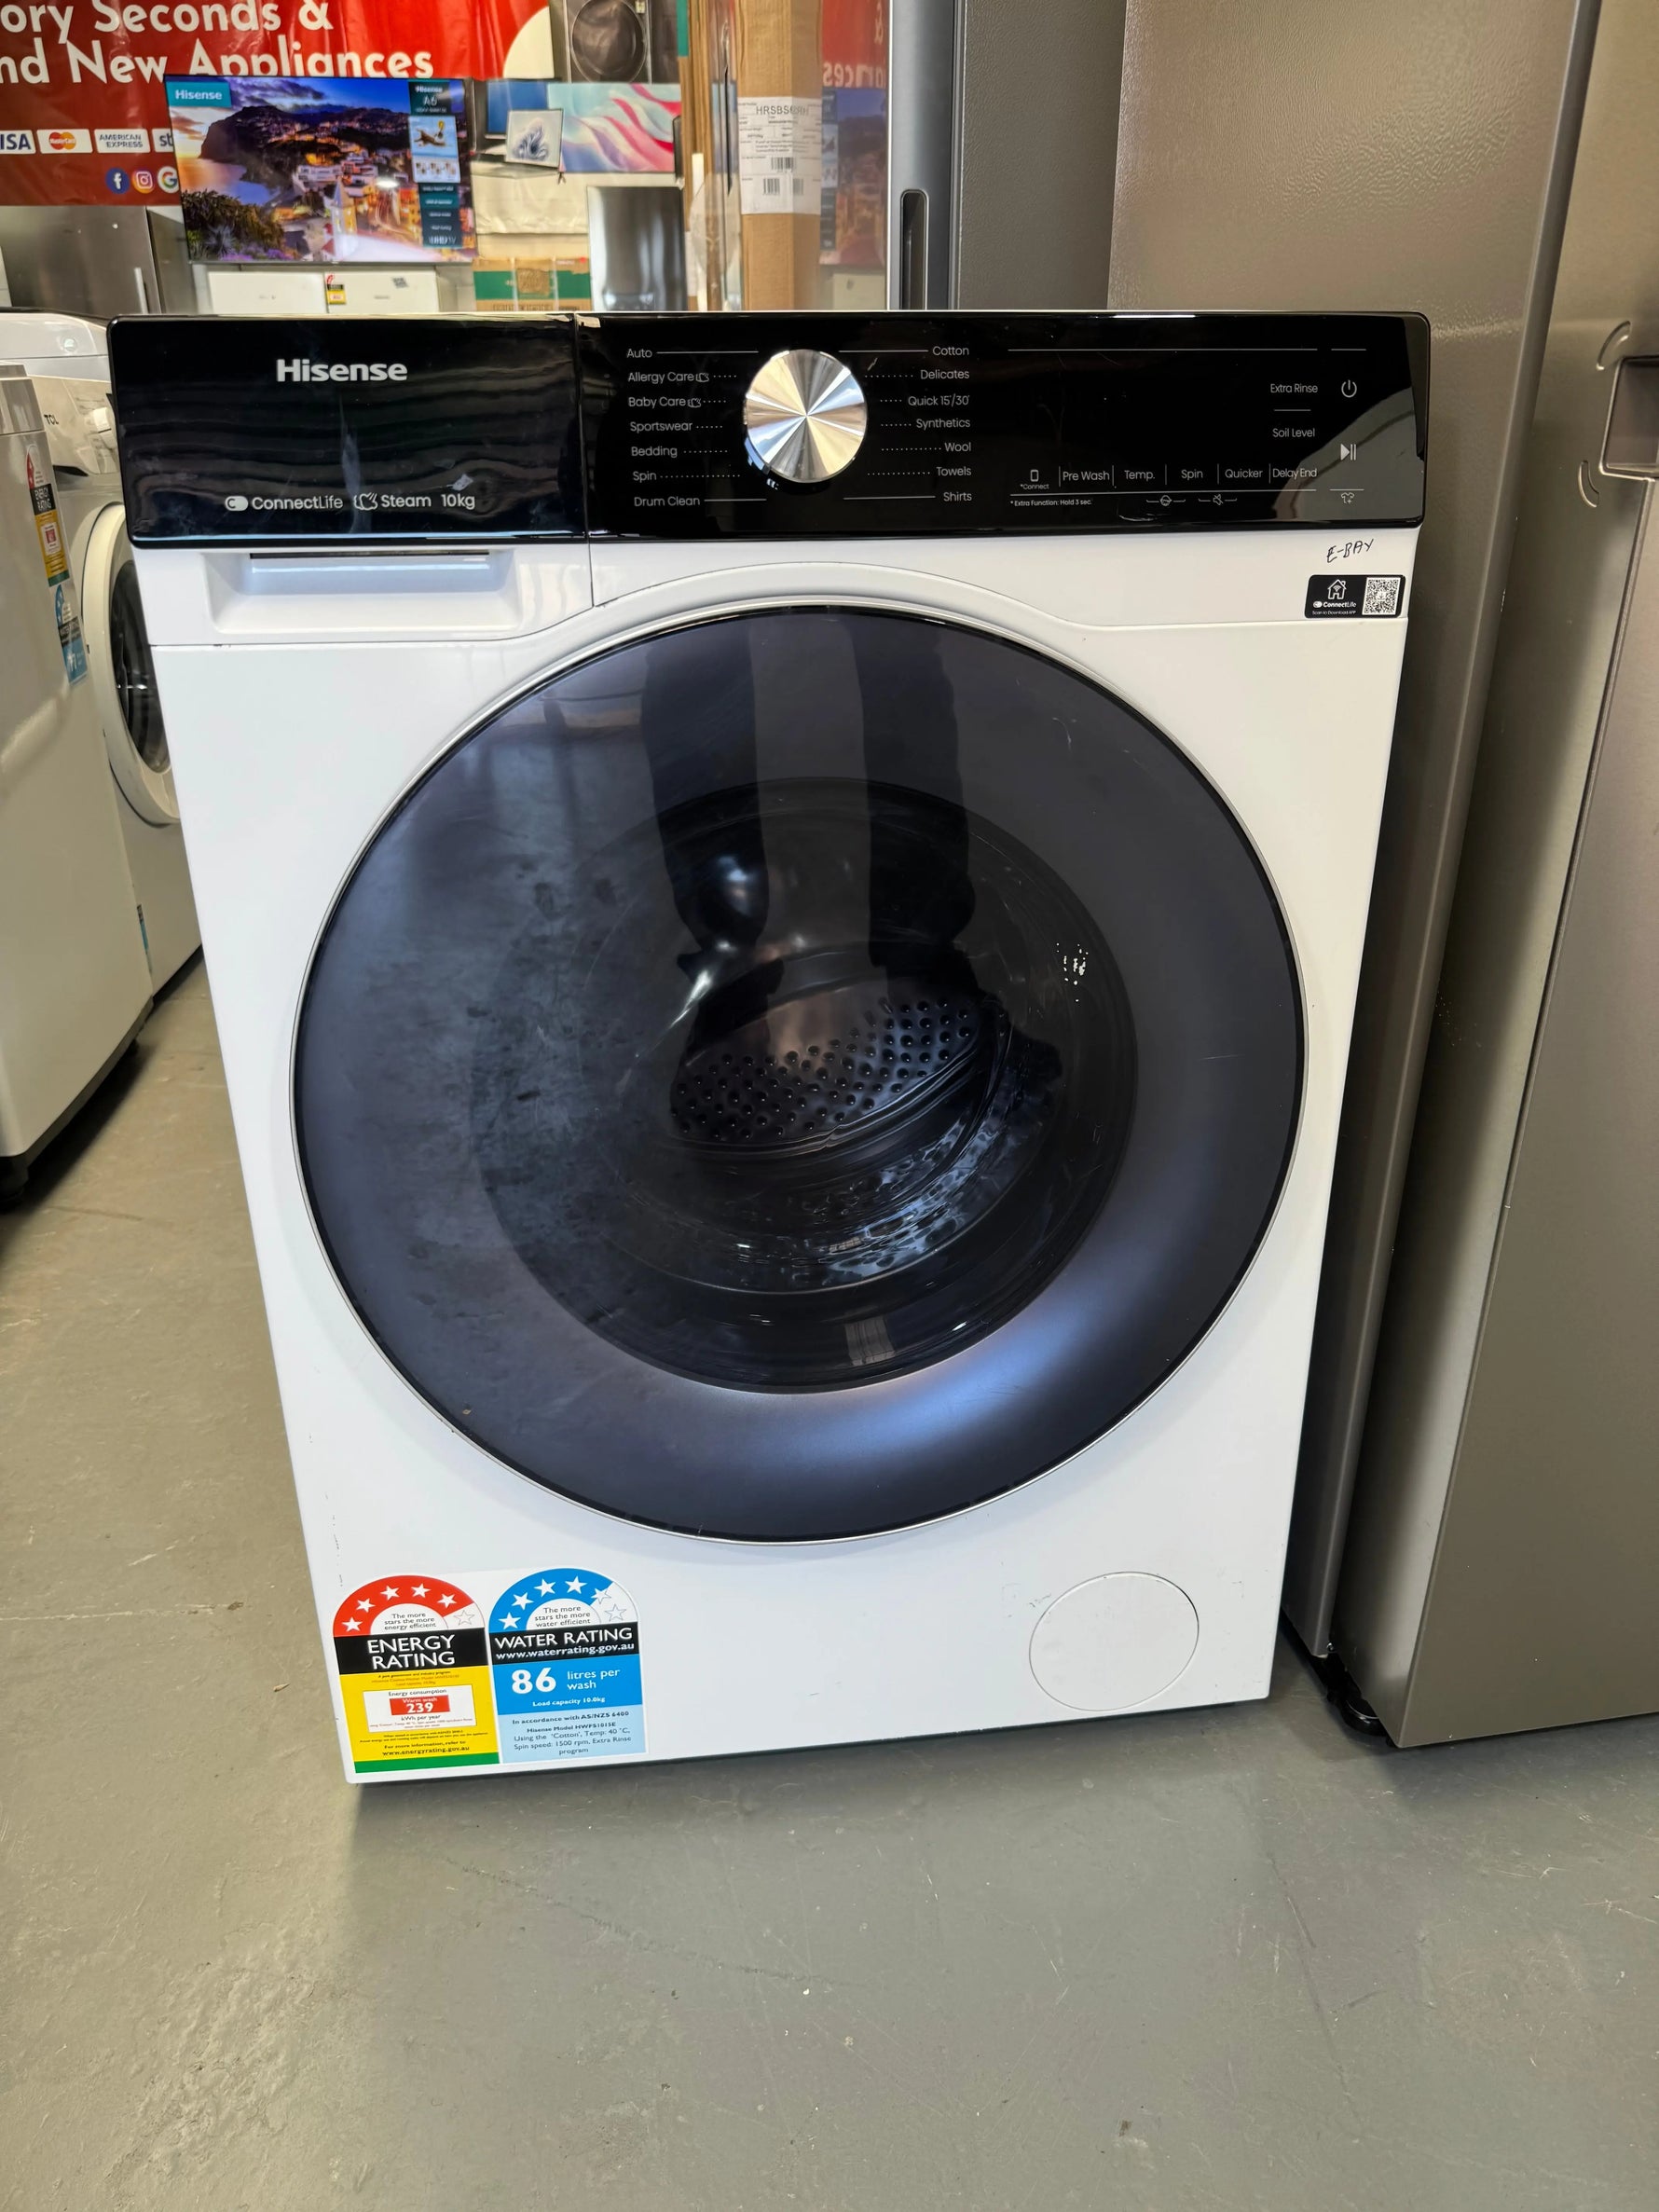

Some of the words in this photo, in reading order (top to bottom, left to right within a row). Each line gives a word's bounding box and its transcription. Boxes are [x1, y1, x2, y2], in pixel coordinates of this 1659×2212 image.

[92, 0, 281, 33] Seconds
[298, 0, 334, 31] &
[66, 39, 168, 84] New
[189, 34, 434, 78] Appliances
[174, 89, 223, 101] Hisense
[99, 133, 142, 142] AMERICAN
[626, 348, 652, 358] Auto
[932, 346, 969, 356] Cotton
[275, 358, 408, 382] Hisense
[920, 369, 970, 380] Delicates
[627, 372, 665, 384] Allergy
[666, 371, 694, 382] Care
[1269, 383, 1293, 393] Extra
[1294, 382, 1319, 393] Rinse
[628, 397, 657, 409] Baby
[659, 396, 686, 407] Care
[908, 395, 939, 407] Quick
[43, 414, 60, 425] TCL
[915, 418, 971, 431] Synthetics
[630, 421, 693, 433] Sportswear
[1272, 427, 1291, 438] Soil
[1292, 427, 1316, 438] Level
[631, 446, 678, 458] Bedding
[944, 442, 971, 452] Wool
[936, 466, 972, 476] Towels
[1063, 471, 1079, 481] Pre
[1080, 471, 1110, 481] Wash
[1124, 470, 1156, 482] Temp.
[1181, 469, 1203, 480] Spin
[1225, 468, 1263, 479] Quicker
[1272, 468, 1298, 480] Delay
[1299, 468, 1318, 478] End
[632, 471, 657, 483] Spin
[252, 496, 344, 511] ConnectLife
[380, 493, 432, 509] Steam
[441, 493, 475, 511] 10kg
[634, 496, 665, 507] Drum
[667, 496, 700, 506] Clean
[943, 491, 972, 502] Shirts
[1326, 538, 1375, 564] E-BAY
[1323, 600, 1357, 609] ConnectLife
[543, 1606, 558, 1614] The
[534, 1614, 554, 1622] stars
[559, 1618, 591, 1627] efficient
[366, 1634, 456, 1655] ENERGY
[494, 1633, 558, 1650] WATER
[563, 1628, 634, 1645] RATING
[495, 1642, 636, 1660] www.waterrating.gov.au
[371, 1651, 456, 1670] RATING
[567, 1669, 596, 1680] litres
[600, 1669, 621, 1678] per
[511, 1667, 557, 1695] 86
[567, 1681, 596, 1690] wash
[405, 1702, 434, 1714] 239
[551, 1698, 582, 1707] capacity
[521, 1716, 562, 1724] accordance
[558, 1748, 589, 1756] program
